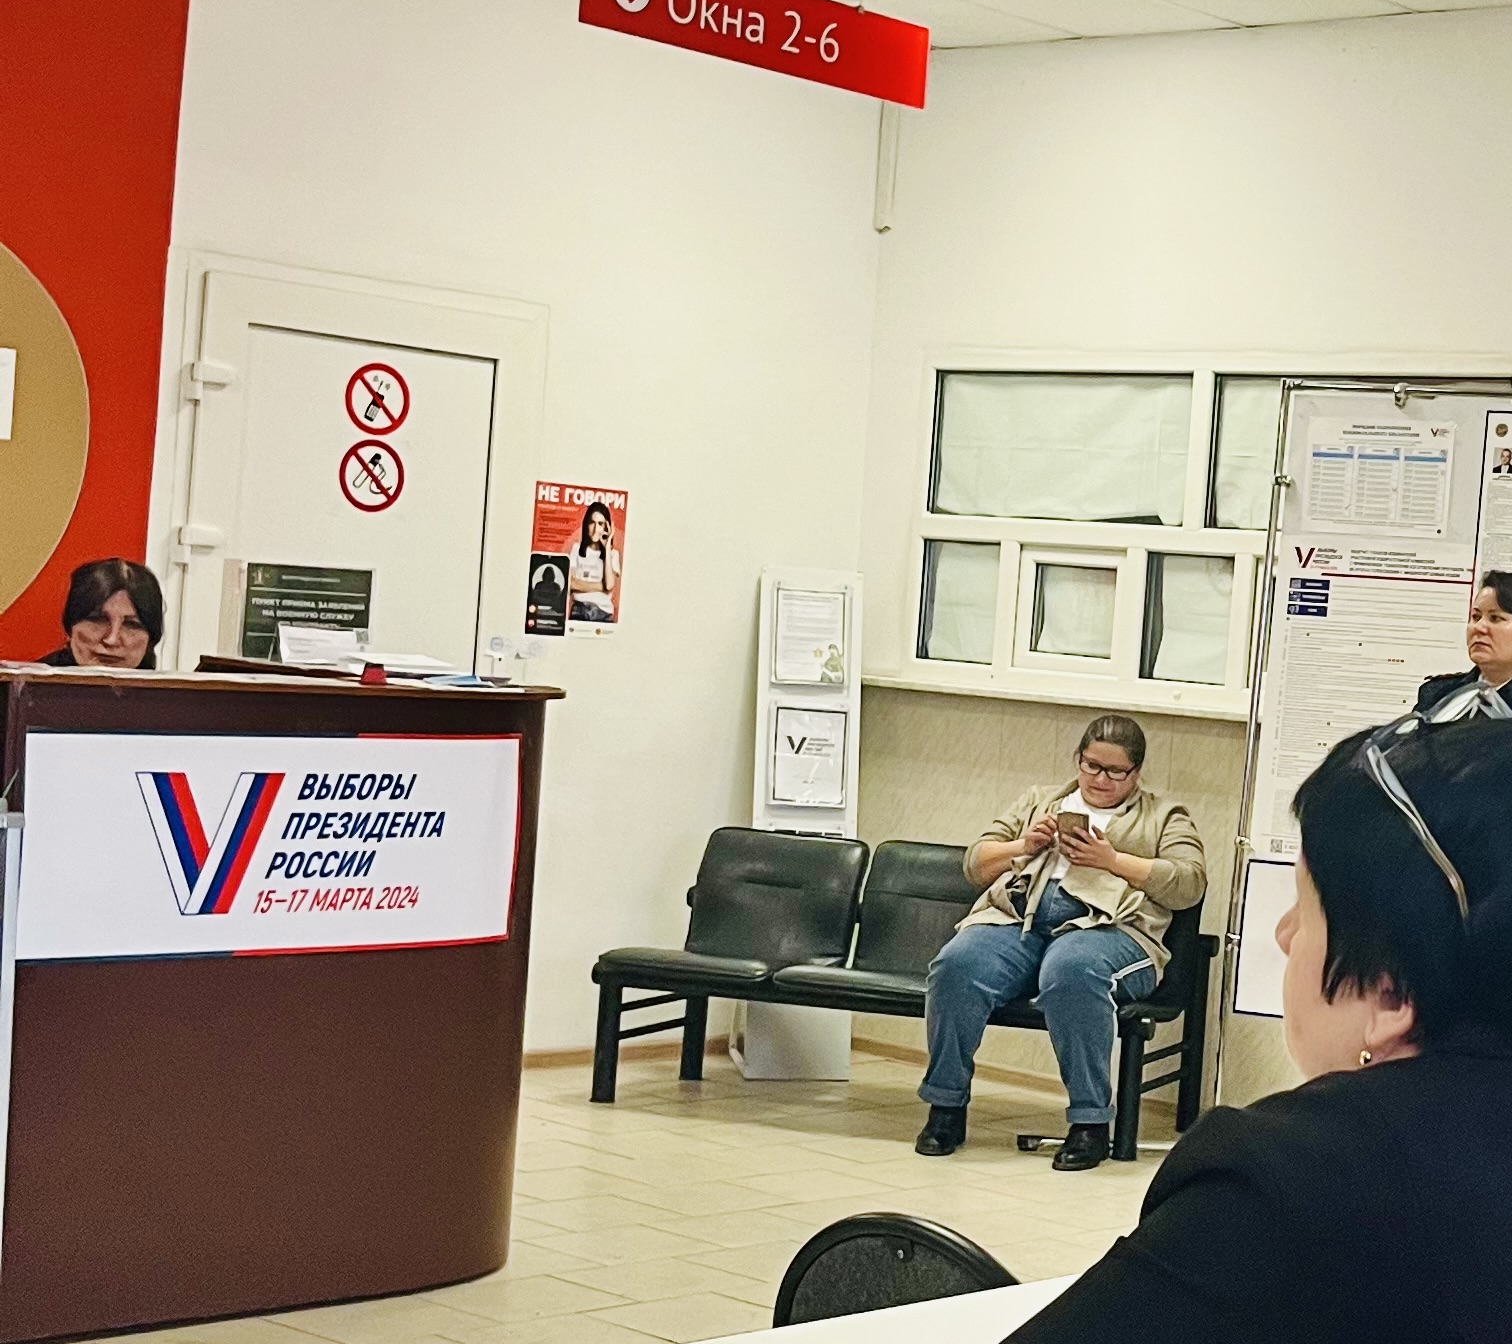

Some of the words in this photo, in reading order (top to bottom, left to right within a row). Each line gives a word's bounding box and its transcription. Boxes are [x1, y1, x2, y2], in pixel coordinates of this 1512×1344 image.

[780, 10, 840, 63] 2-6
[538, 484, 560, 503] НЕ
[563, 487, 626, 511] ГОВОРИ
[297, 773, 418, 801] ВЫБОРЫ
[280, 811, 446, 843] ПРЕЗИДЕНТА
[264, 850, 377, 880] РОССИИ
[308, 887, 376, 913] МАРТА
[375, 885, 420, 911] 2024
